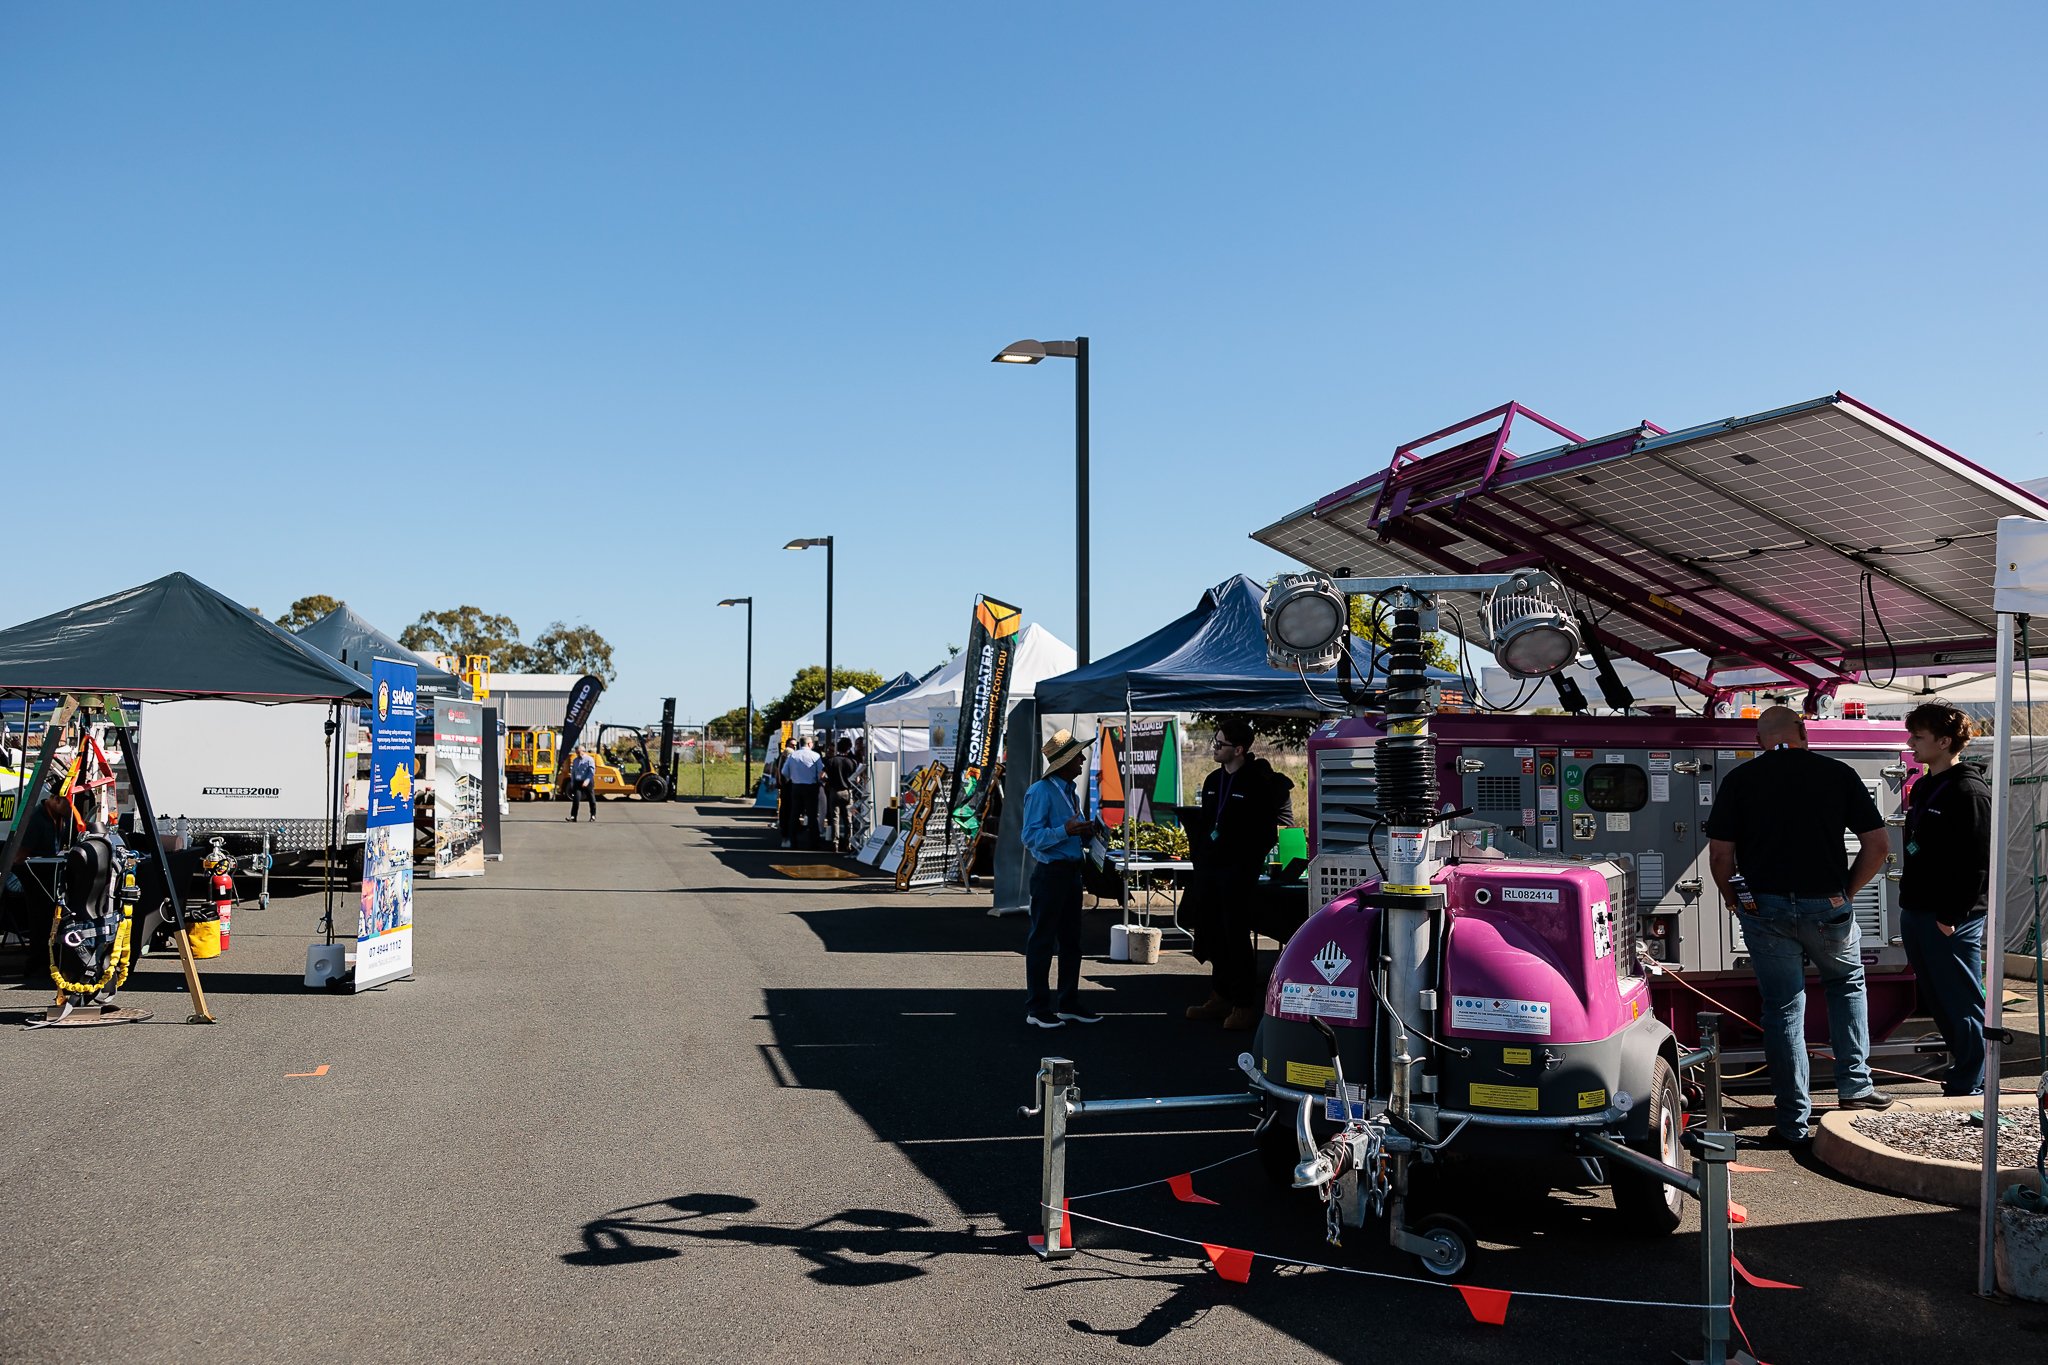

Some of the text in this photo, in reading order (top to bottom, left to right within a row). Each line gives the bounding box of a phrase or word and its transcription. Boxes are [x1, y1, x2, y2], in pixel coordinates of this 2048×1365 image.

[392, 686, 414, 705] SHARP
[567, 684, 590, 723] UNITED
[968, 644, 991, 764] CONSOLIDATED
[1145, 750, 1157, 761] WAY
[1130, 764, 1156, 774] THINKING
[1504, 890, 1553, 900] RL082414
